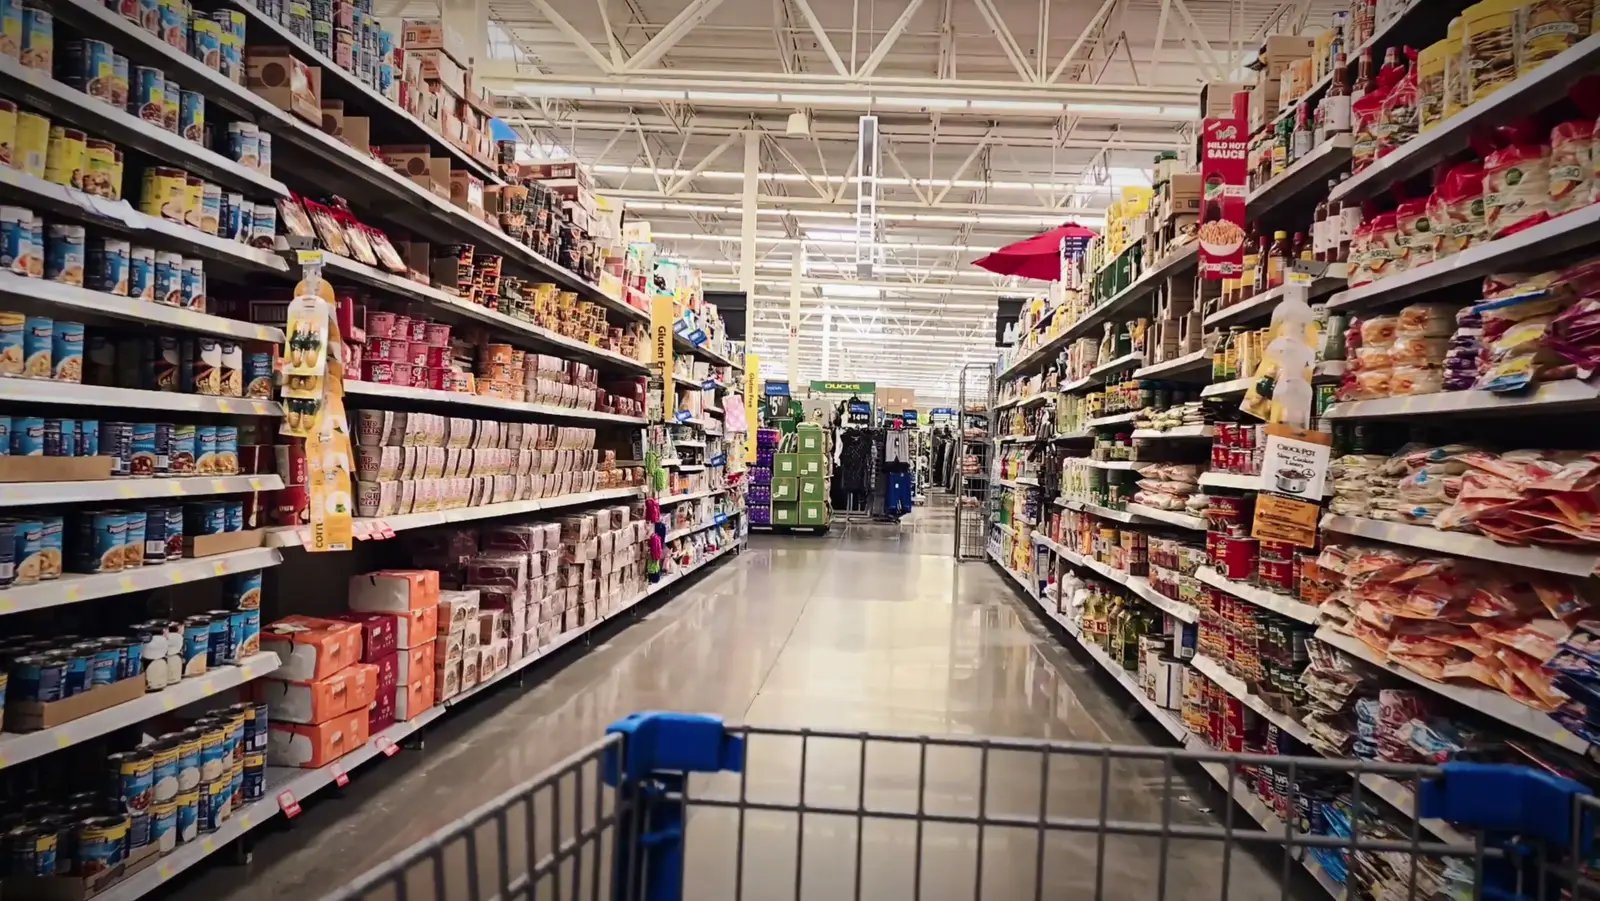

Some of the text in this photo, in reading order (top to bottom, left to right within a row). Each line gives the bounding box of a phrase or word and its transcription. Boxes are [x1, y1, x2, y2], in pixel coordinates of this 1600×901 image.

[1207, 141, 1228, 149] MILD
[1207, 149, 1246, 159] SAUCE
[657, 325, 666, 358] Gluten
[315, 522, 324, 549] corn
